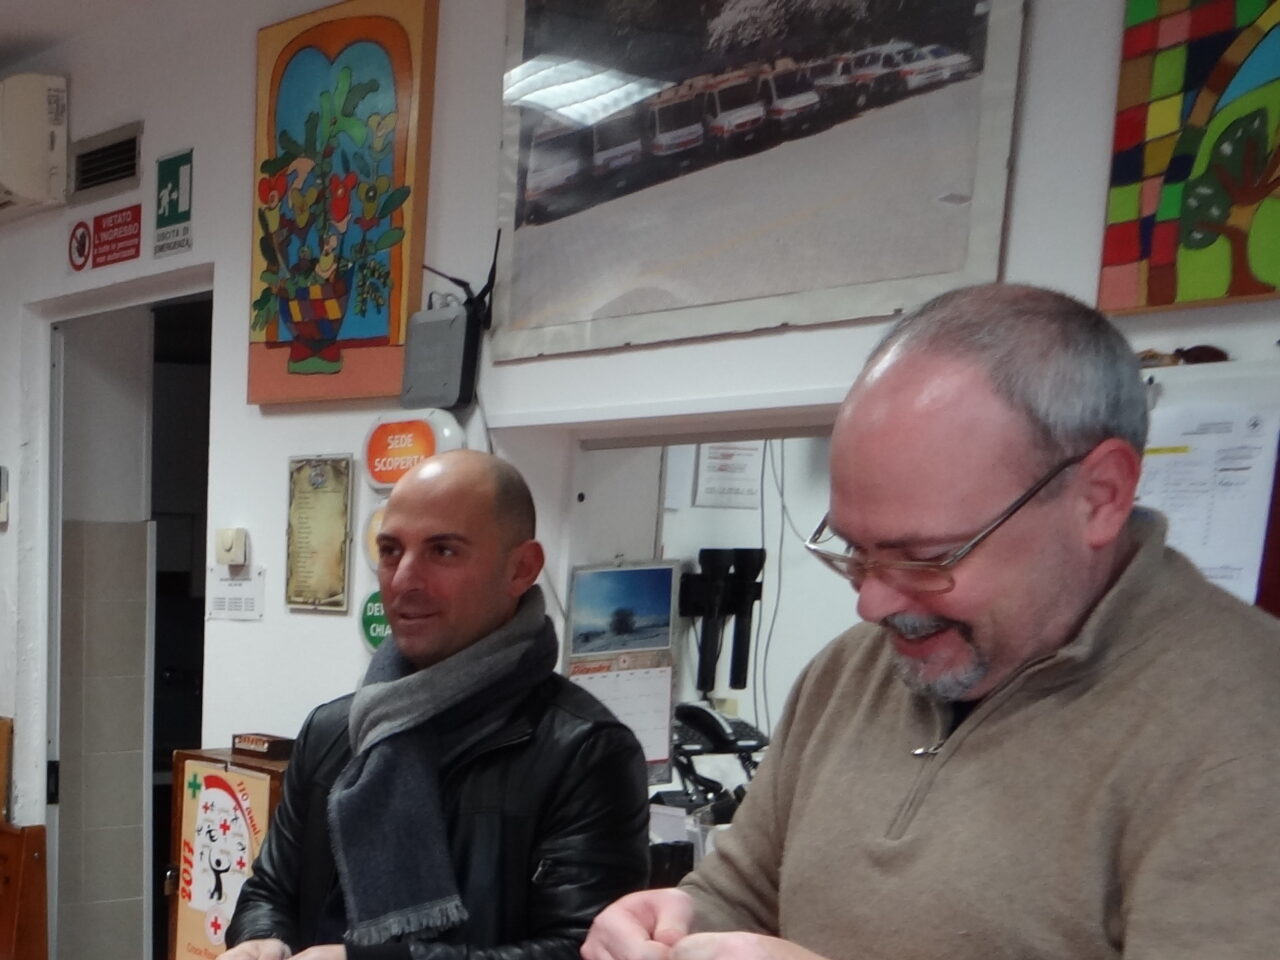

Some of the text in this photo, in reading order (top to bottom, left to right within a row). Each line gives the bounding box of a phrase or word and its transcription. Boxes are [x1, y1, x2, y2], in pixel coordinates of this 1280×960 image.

[102, 210, 132, 228] VIETATO
[157, 226, 189, 242] USCITA DI
[387, 434, 413, 449] SEDE
[370, 623, 392, 637] CHIA
[181, 839, 194, 902] 2017
